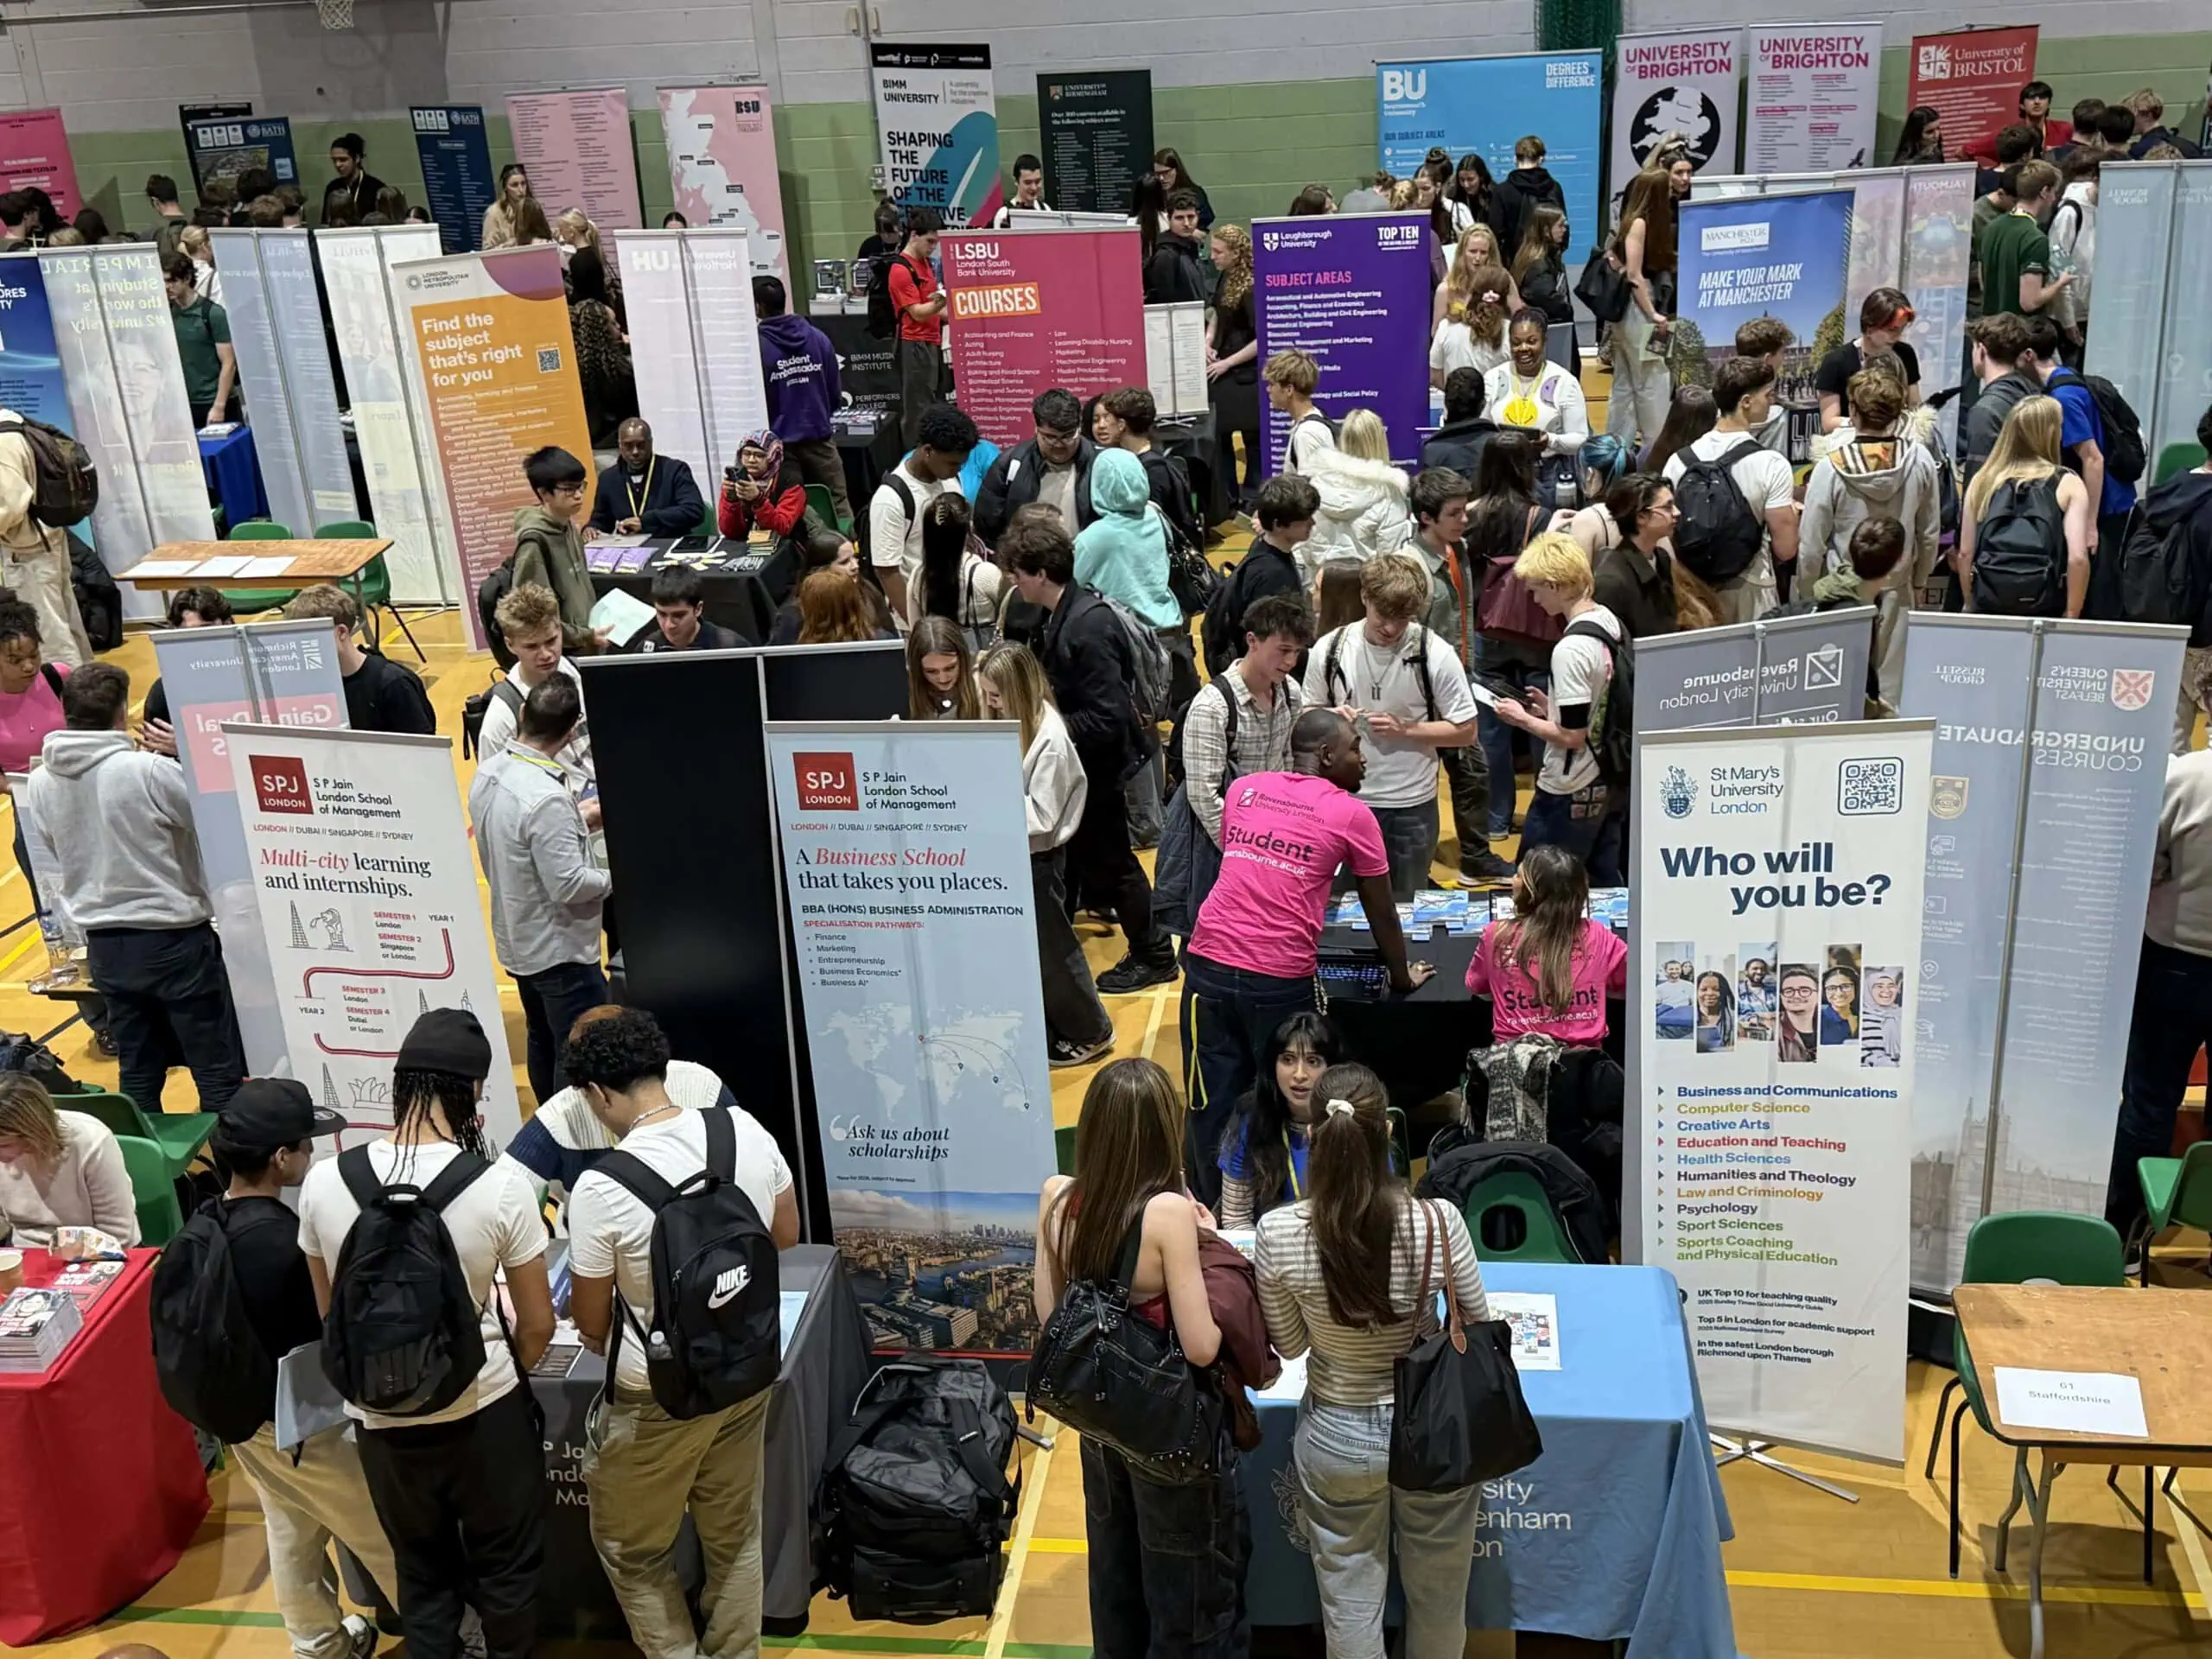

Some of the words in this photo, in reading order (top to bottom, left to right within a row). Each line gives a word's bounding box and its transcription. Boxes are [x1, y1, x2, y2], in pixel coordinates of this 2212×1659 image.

[1626, 41, 1730, 62] UNIVERSITY
[1760, 36, 1863, 53] UNIVERSITY
[1955, 47, 2009, 60] University
[2012, 42, 2026, 56] of
[1546, 62, 1589, 75] DEGREES
[1638, 59, 1731, 79] BRIGHTON
[1772, 53, 1868, 69] BRIGHTON
[1955, 58, 2026, 78] BRISTOL
[883, 79, 907, 89] BIMM
[1382, 68, 1426, 101] BU
[1546, 74, 1595, 88] DIFFERENCE
[884, 93, 939, 104] UNIVERSITY
[735, 101, 760, 113] BSU
[887, 131, 954, 148] SHAPING
[889, 149, 918, 164] THE
[892, 168, 949, 184] FUTURE
[893, 187, 913, 200] OF
[916, 188, 945, 202] THE
[1281, 230, 1332, 241] Loughborough
[1378, 227, 1397, 240] TOP
[1400, 226, 1419, 239] TEN
[955, 242, 999, 259] LSBU
[1281, 240, 1316, 249] University
[1266, 273, 1313, 288] SUBJECT
[1315, 271, 1351, 284] AREAS
[1699, 270, 1734, 290] MAKE
[1735, 266, 1768, 288] YOUR
[1767, 264, 1802, 283] MARK
[956, 286, 1037, 315] COURSES
[1699, 289, 1714, 308] AT
[1714, 283, 1793, 307] MANCHESTER
[422, 315, 461, 334] Find
[465, 314, 494, 327] the
[425, 331, 491, 352] subject
[429, 350, 478, 369] that's
[481, 345, 523, 364] right
[777, 354, 810, 370] Student
[433, 373, 456, 387] for
[461, 369, 493, 386] you
[770, 363, 823, 383] Ambassador
[806, 771, 845, 790] SPJ
[862, 772, 869, 782] S
[874, 772, 880, 781] P
[883, 772, 906, 783] Jain
[1711, 766, 1728, 780] St
[1730, 766, 1780, 781] Mary's
[262, 774, 299, 793] SPJ
[864, 785, 906, 796] London
[910, 785, 948, 797] School
[1711, 783, 1783, 798] University
[805, 795, 851, 804] LONDON
[866, 799, 878, 810] of
[880, 800, 957, 811] Management
[1711, 801, 1767, 814] London
[261, 849, 349, 874] Multi-city
[353, 853, 431, 878] learning
[796, 849, 810, 864] A
[816, 847, 897, 866] Business
[902, 848, 967, 867] School
[1660, 846, 1755, 878] Who
[1764, 842, 1834, 874] will
[265, 873, 299, 891] and
[303, 874, 412, 899] internships.
[798, 871, 839, 889] that
[843, 872, 893, 889] takes
[898, 874, 935, 893] you
[940, 871, 1008, 893] places.
[1731, 884, 1805, 915] you
[1815, 874, 1891, 907] be?
[373, 911, 410, 921] SEMESTER
[802, 905, 825, 913] BBA
[828, 906, 867, 914] (HONS)
[869, 906, 925, 914] BUSINESS
[927, 906, 1023, 916] ADMINISTRATION
[818, 957, 885, 965] Entrepreneurship
[1677, 1086, 1743, 1097] Business
[1745, 1085, 1770, 1096] and
[1773, 1085, 1897, 1099] Communications
[1677, 1103, 1749, 1116] Computer
[1751, 1103, 1810, 1113] Science
[846, 1125, 875, 1140] Ask
[880, 1128, 898, 1141] us
[903, 1127, 950, 1141] about
[1677, 1120, 1737, 1131] Creative
[1739, 1119, 1770, 1129] Arts
[849, 1143, 949, 1161] scholarships
[1677, 1137, 1749, 1148] Education
[1751, 1137, 1778, 1147] and
[1781, 1137, 1846, 1153] Teaching
[1677, 1154, 1723, 1165] Health
[1726, 1153, 1791, 1165] Sciences
[1677, 1169, 1757, 1182] Humanities
[1759, 1171, 1785, 1181] and
[1788, 1171, 1856, 1186] Theology
[1677, 1187, 1706, 1198] Law
[1708, 1185, 1734, 1197] and
[1737, 1186, 1823, 1201] Criminology
[1677, 1203, 1758, 1216] Psychology
[1677, 1220, 1716, 1233] Sport
[1719, 1219, 1783, 1231] Sciences
[1677, 1236, 1723, 1249] Sports
[1726, 1236, 1793, 1249] Coaching
[1677, 1250, 1703, 1261] and
[1705, 1249, 1763, 1262] Physical
[1766, 1251, 1838, 1266] Education
[715, 1265, 747, 1294] NIKE
[1713, 1289, 1732, 1299] Top
[1734, 1316, 1770, 1326] London
[1787, 1321, 1835, 1332] academic
[1837, 1325, 1875, 1337] support
[1697, 1349, 1745, 1358] Richmond
[1773, 1352, 1811, 1363] Thames
[2029, 1390, 2111, 1404] Staffordshire
